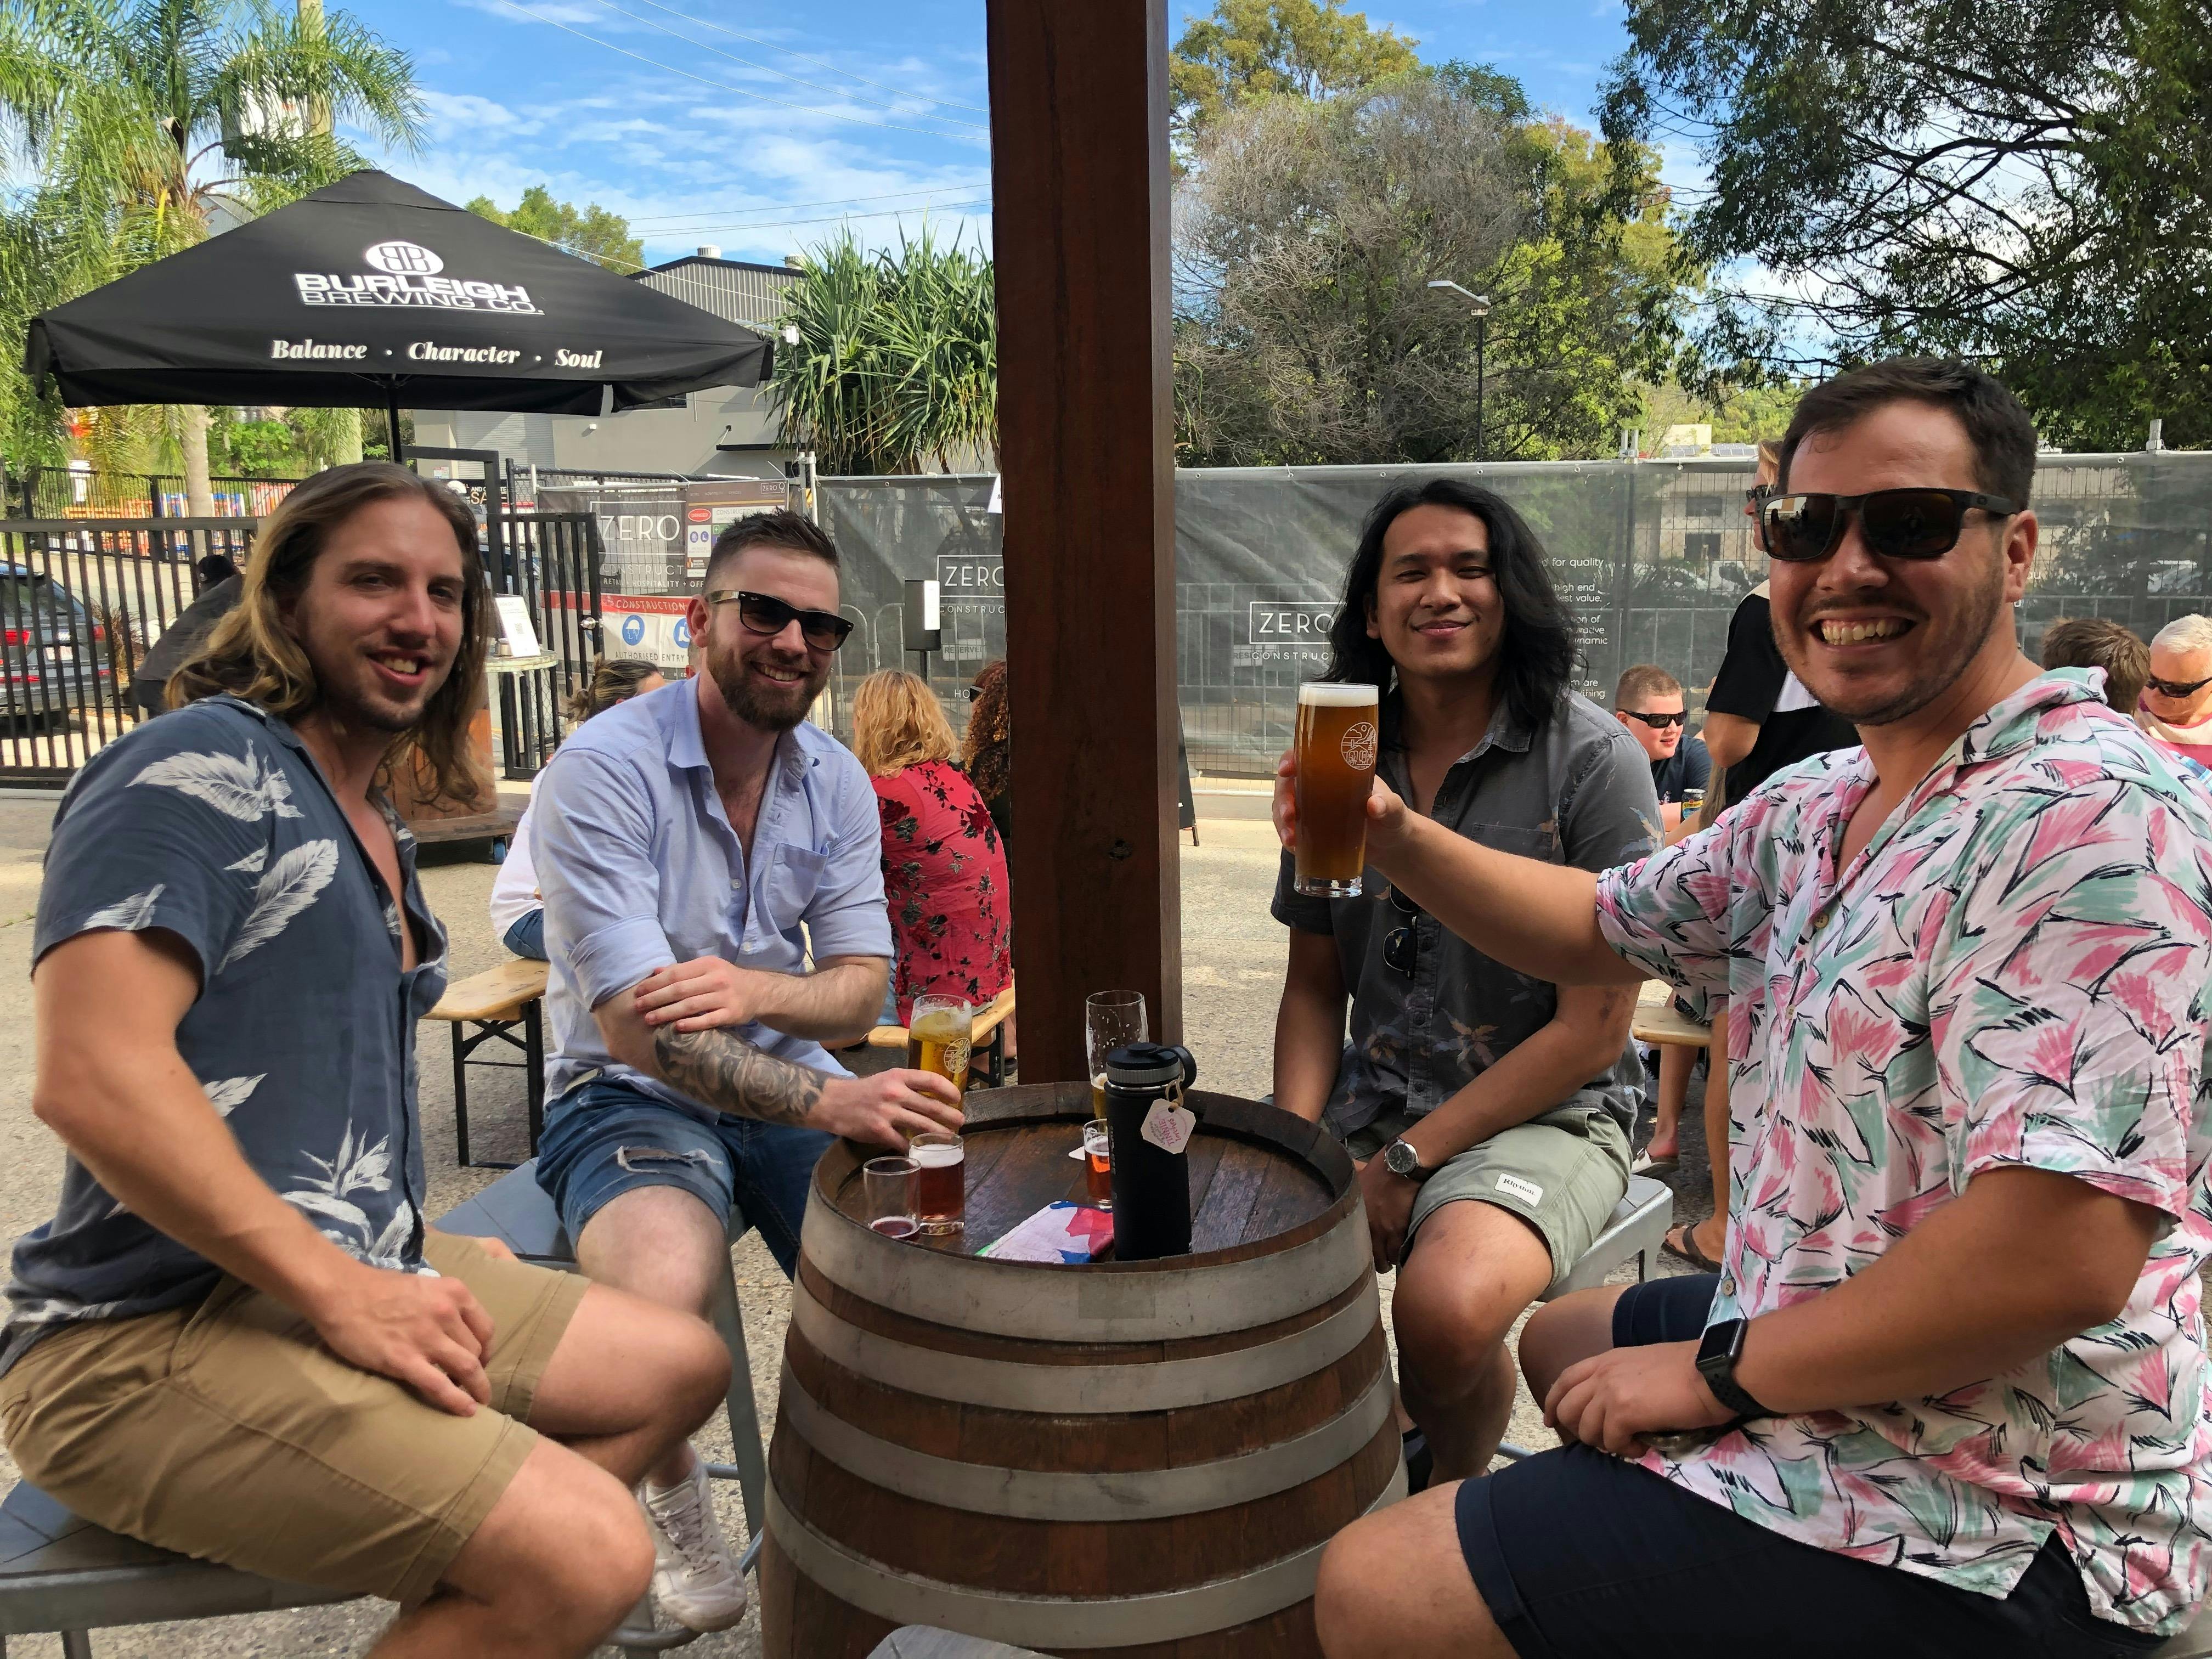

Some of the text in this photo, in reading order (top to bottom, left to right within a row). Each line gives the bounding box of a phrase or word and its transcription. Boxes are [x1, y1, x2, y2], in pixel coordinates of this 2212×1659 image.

[295, 274, 531, 302] BURLEIGH
[301, 291, 543, 313] BREWING CO.
[272, 338, 602, 368] Balance Character Soul
[600, 515, 680, 540] ZERO
[1553, 557, 1566, 567] for
[1570, 557, 1604, 568] quality
[602, 563, 684, 575] CONSTRUCT
[1554, 583, 1595, 594] high end
[1576, 594, 1602, 602] value.
[616, 599, 686, 611] CONSTRUCTION
[1591, 615, 1601, 623] of
[616, 651, 685, 662] AUTHORISED ENTRY
[1251, 652, 1334, 660] CONSTRUC
